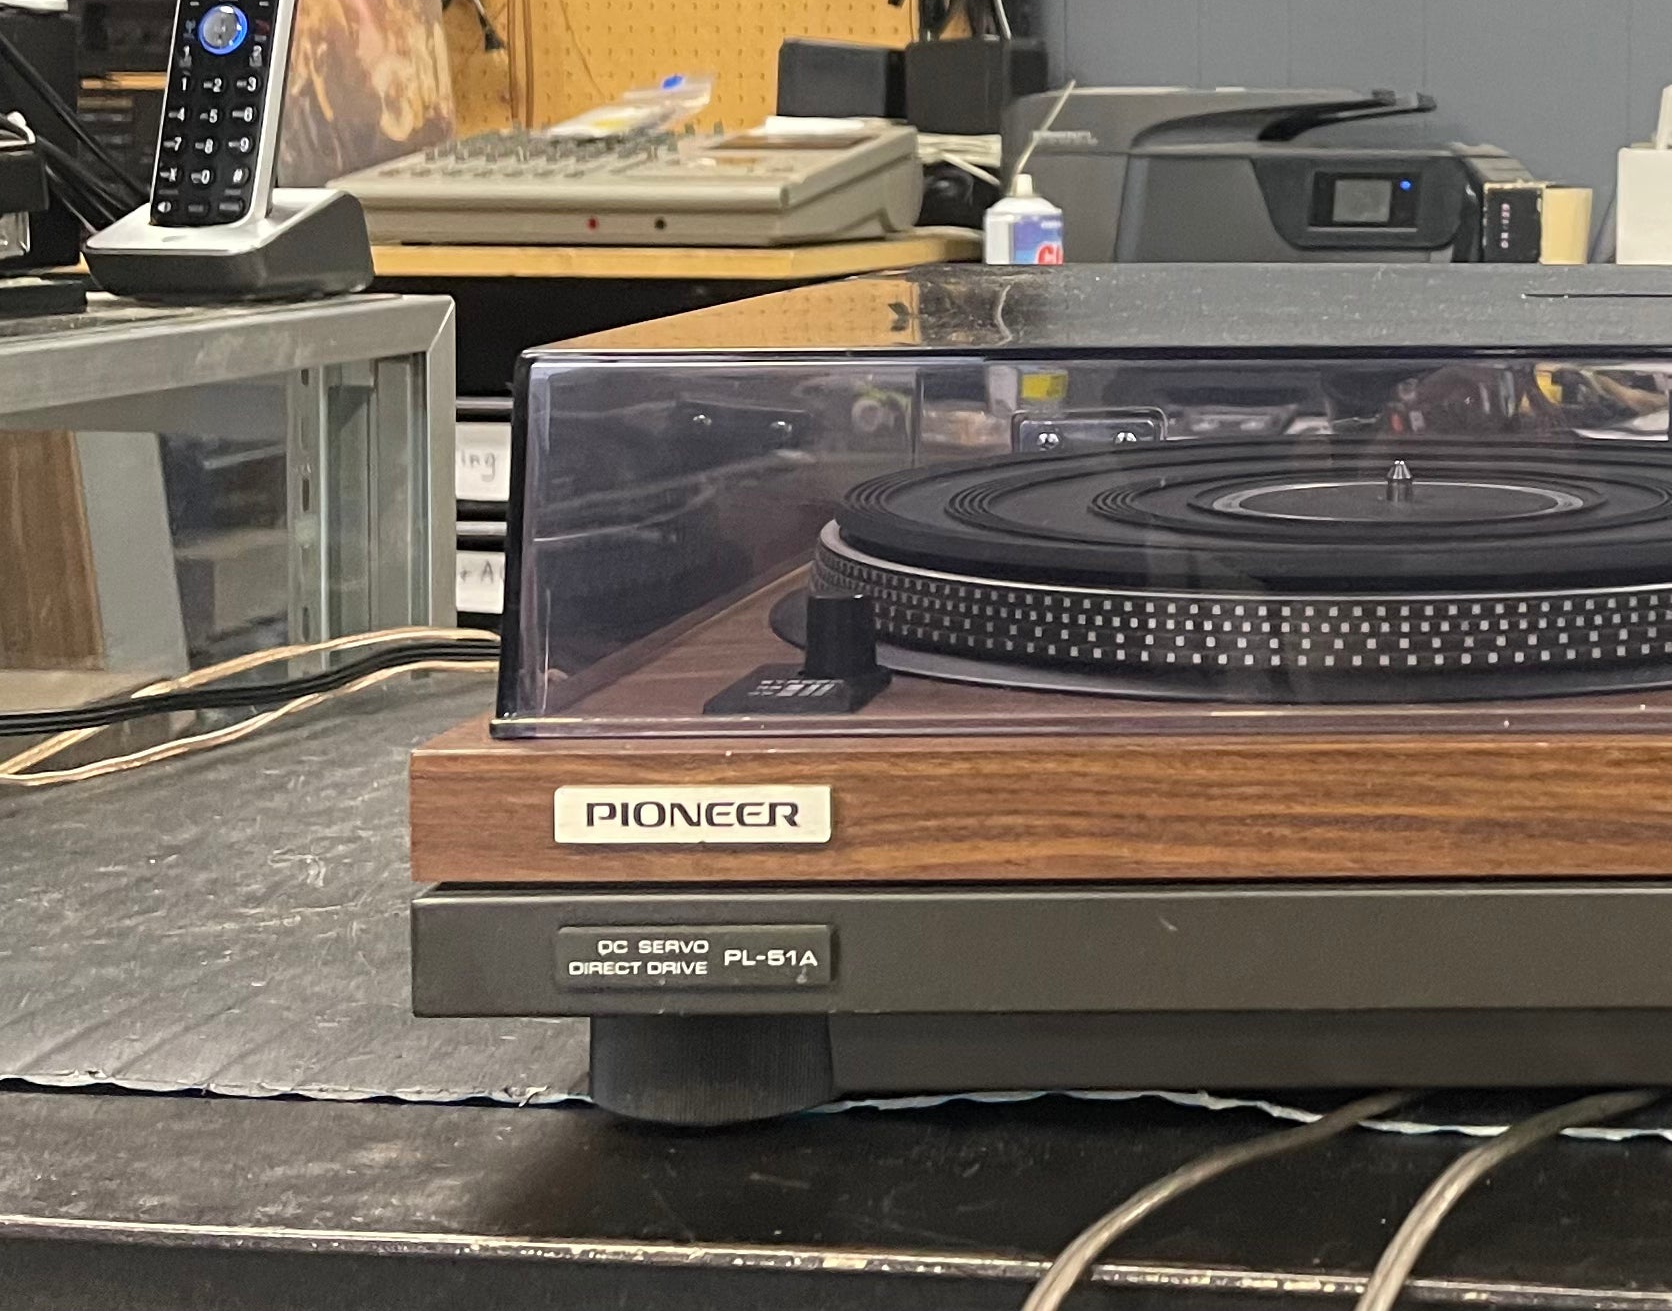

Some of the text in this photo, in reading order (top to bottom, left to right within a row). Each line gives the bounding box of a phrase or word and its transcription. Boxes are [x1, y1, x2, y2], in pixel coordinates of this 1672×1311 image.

[212, 77, 222, 93] 2
[247, 76, 257, 92] 3
[176, 106, 185, 123] 4
[208, 108, 218, 124] 5
[174, 136, 250, 155] 7 8 9
[586, 801, 800, 828] PIONEER
[638, 939, 709, 954] SERVO
[723, 949, 818, 967] PL-51A
[568, 961, 708, 976] DIRECT DRIVE
